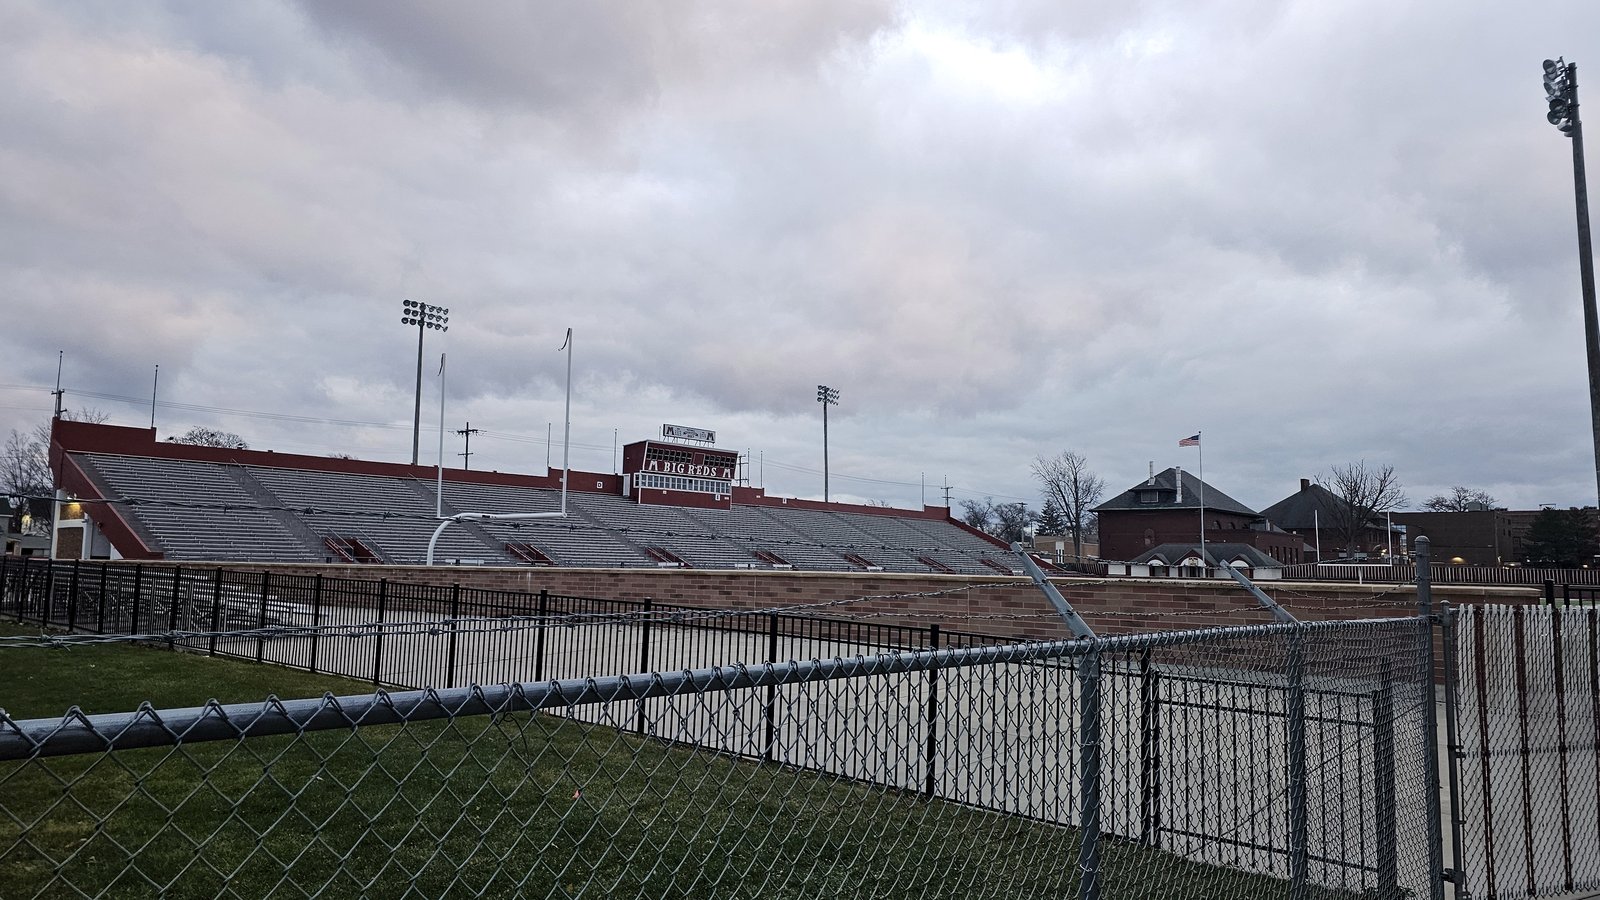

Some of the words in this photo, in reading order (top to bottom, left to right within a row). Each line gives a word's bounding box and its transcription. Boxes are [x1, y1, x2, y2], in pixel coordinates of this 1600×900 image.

[666, 426, 674, 435] M
[706, 432, 714, 441] M
[648, 460, 658, 471] M
[663, 461, 685, 474] BIG
[687, 464, 717, 477] REDS
[722, 468, 731, 478] M
